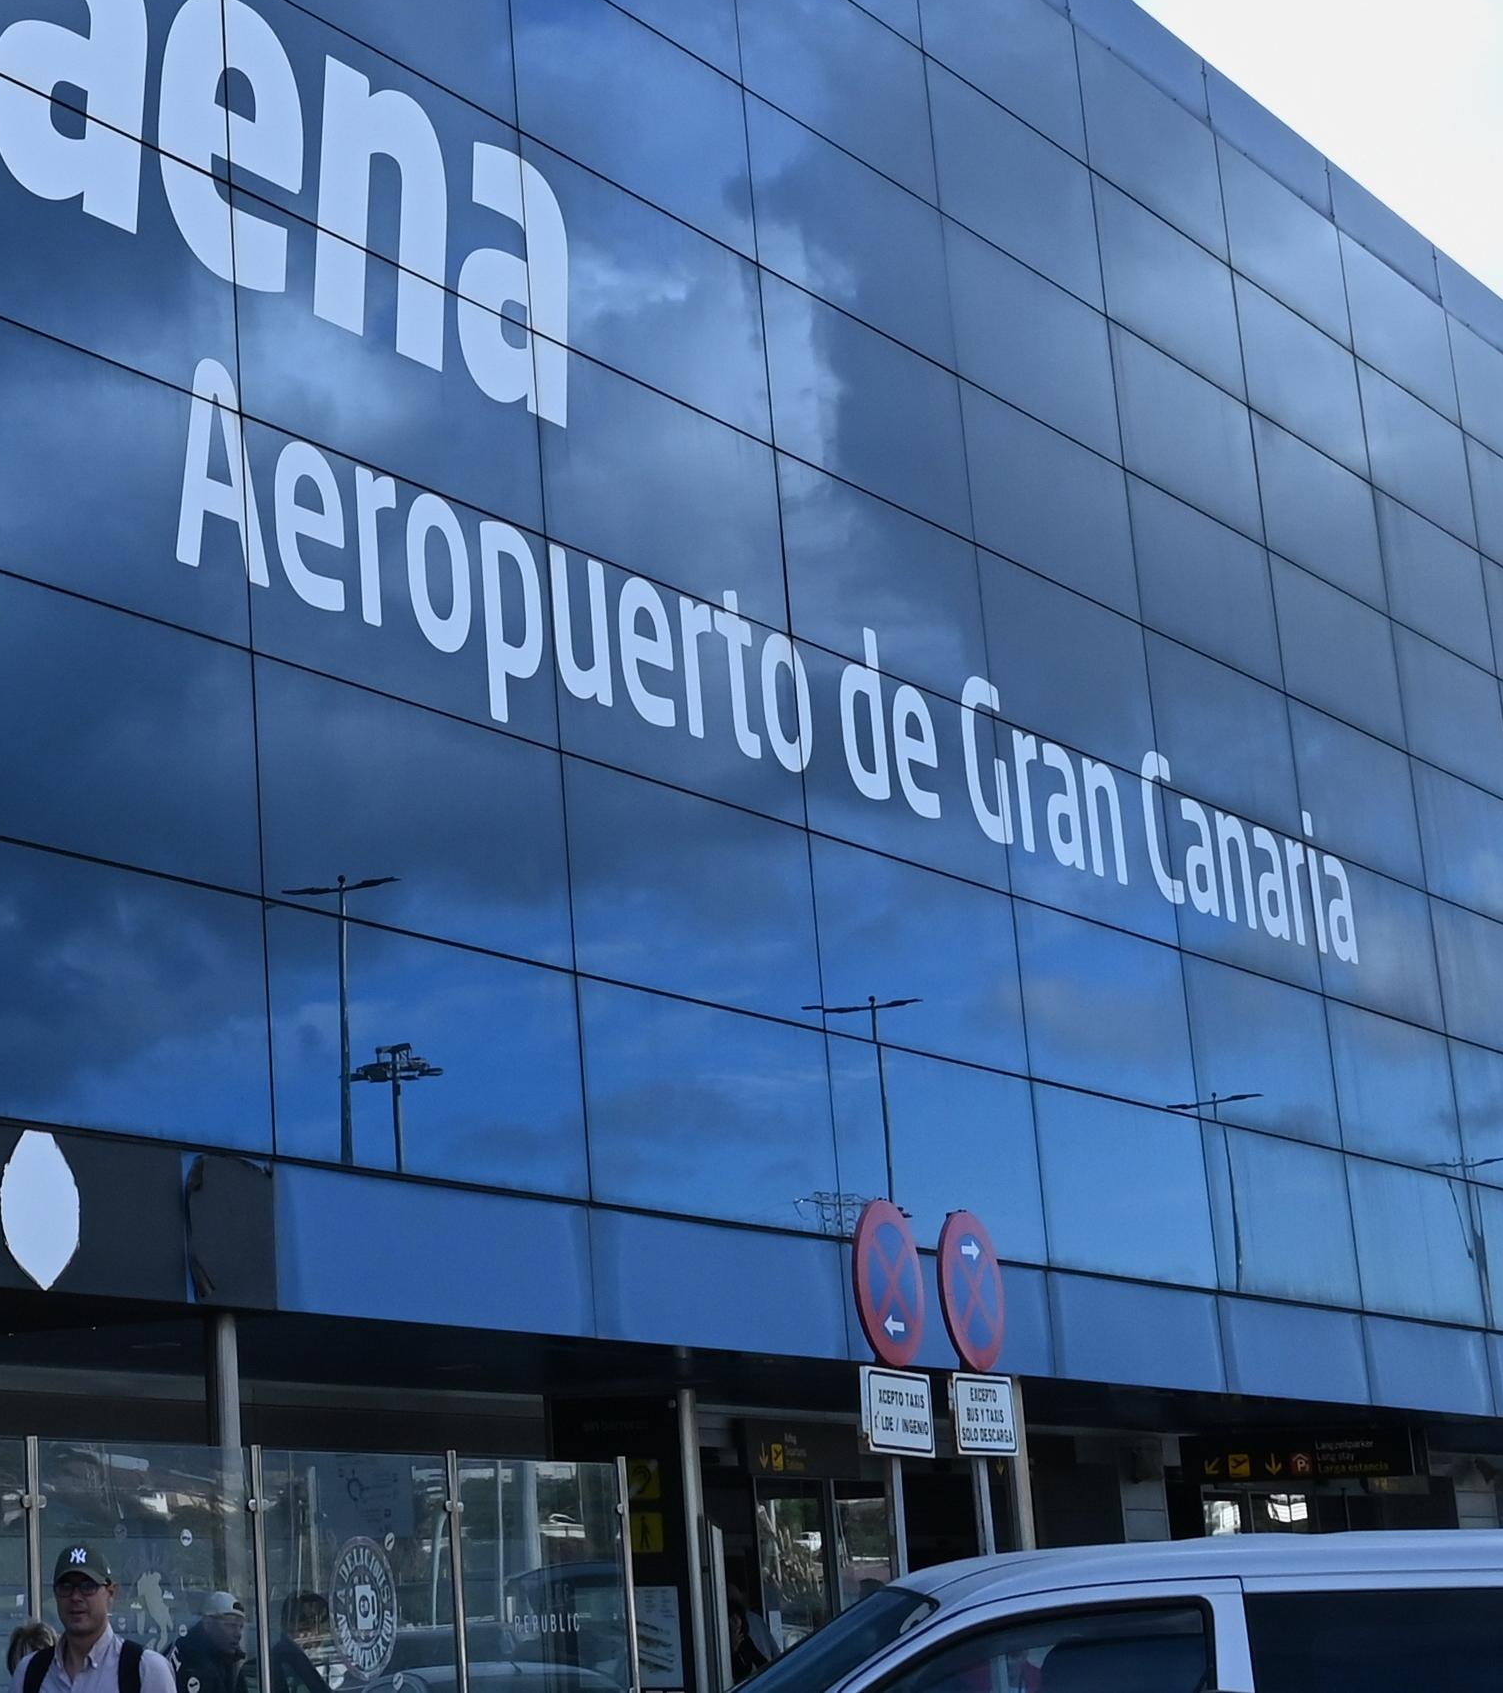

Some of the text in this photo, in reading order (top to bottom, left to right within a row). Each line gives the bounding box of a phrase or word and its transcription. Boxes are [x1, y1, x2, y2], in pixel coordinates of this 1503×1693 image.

[175, 357, 1359, 966] Aeropuerto de Gran Canaria
[970, 1387, 997, 1403] EXCEPTO
[966, 1407, 979, 1422] BUS
[986, 1408, 1005, 1423] TAXIS
[962, 1427, 1013, 1444] SOLO DESCARGA
